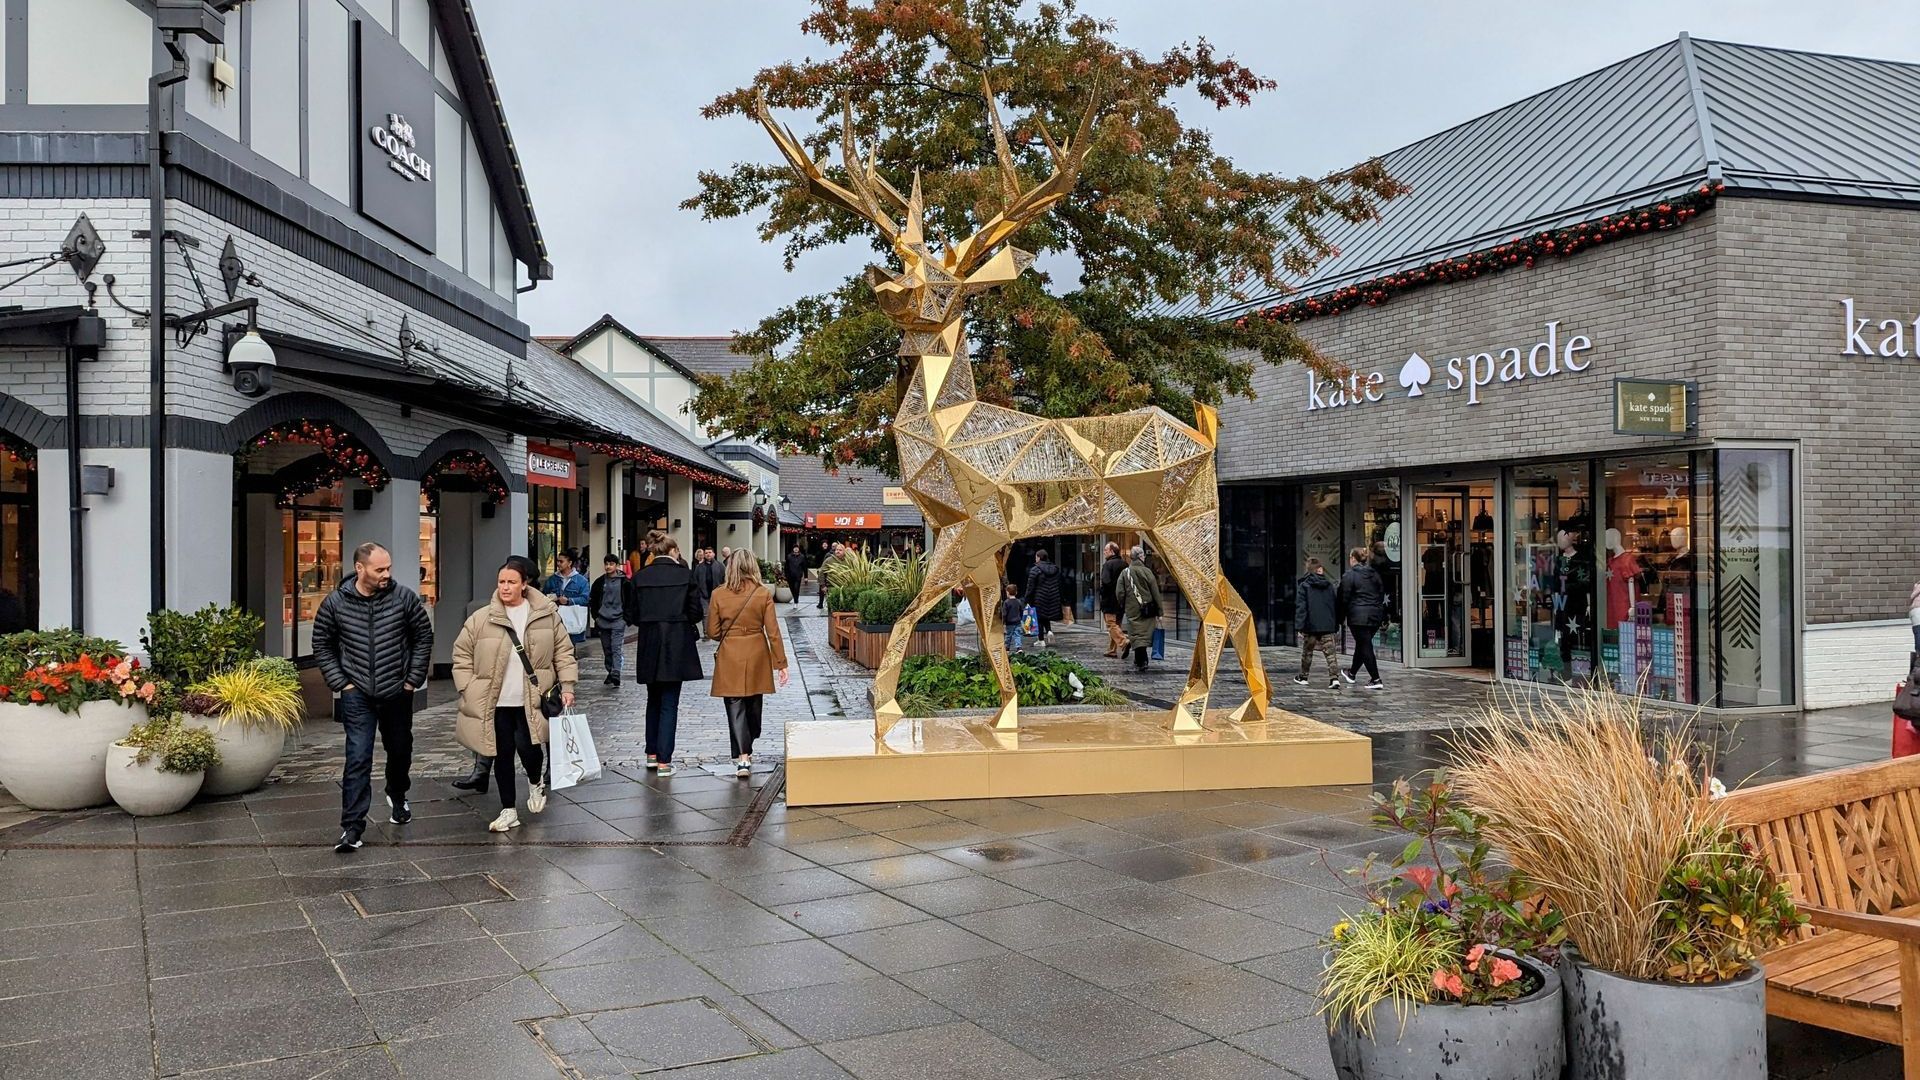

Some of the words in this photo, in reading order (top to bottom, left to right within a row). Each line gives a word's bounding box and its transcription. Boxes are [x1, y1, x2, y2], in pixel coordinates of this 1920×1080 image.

[372, 126, 431, 182] COACH
[1447, 320, 1592, 405] spade
[1629, 401, 1647, 412] kate
[1649, 403, 1674, 415] spade
[538, 458, 546, 469] LE
[545, 460, 569, 473] CREUSET
